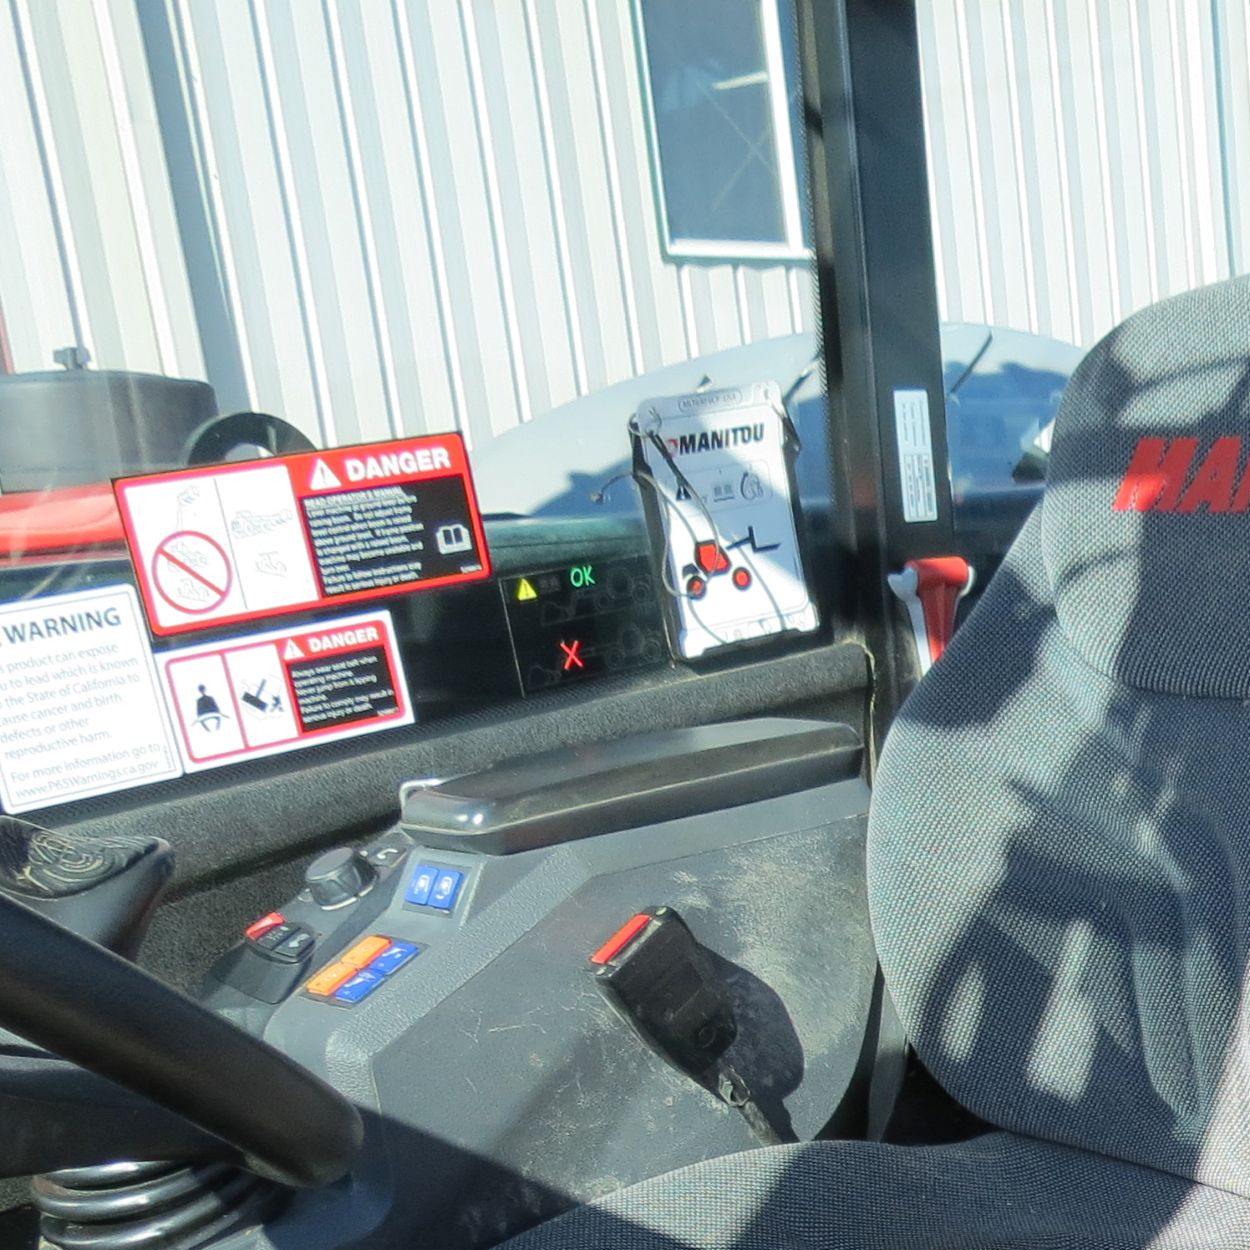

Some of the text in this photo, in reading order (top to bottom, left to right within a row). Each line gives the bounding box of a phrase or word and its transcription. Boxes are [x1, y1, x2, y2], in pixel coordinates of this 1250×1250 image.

[680, 423, 764, 455] MANITOU
[345, 447, 451, 481] DANGER
[570, 565, 595, 587] OK
[3, 607, 122, 644] WARNING
[308, 626, 379, 652] DANGER
[7, 643, 118, 674] product can expose
[10, 678, 23, 690] to
[25, 672, 49, 687] lead
[53, 666, 86, 681] which
[89, 662, 98, 674] is
[100, 657, 138, 672] known
[5, 673, 140, 708] the State of California to
[31, 706, 68, 722] cancer
[71, 698, 91, 713] and
[95, 693, 122, 708] birth
[45, 725, 57, 736] or
[59, 717, 89, 732] other
[5, 735, 78, 760] reproductive
[11, 743, 160, 782] For more information go to
